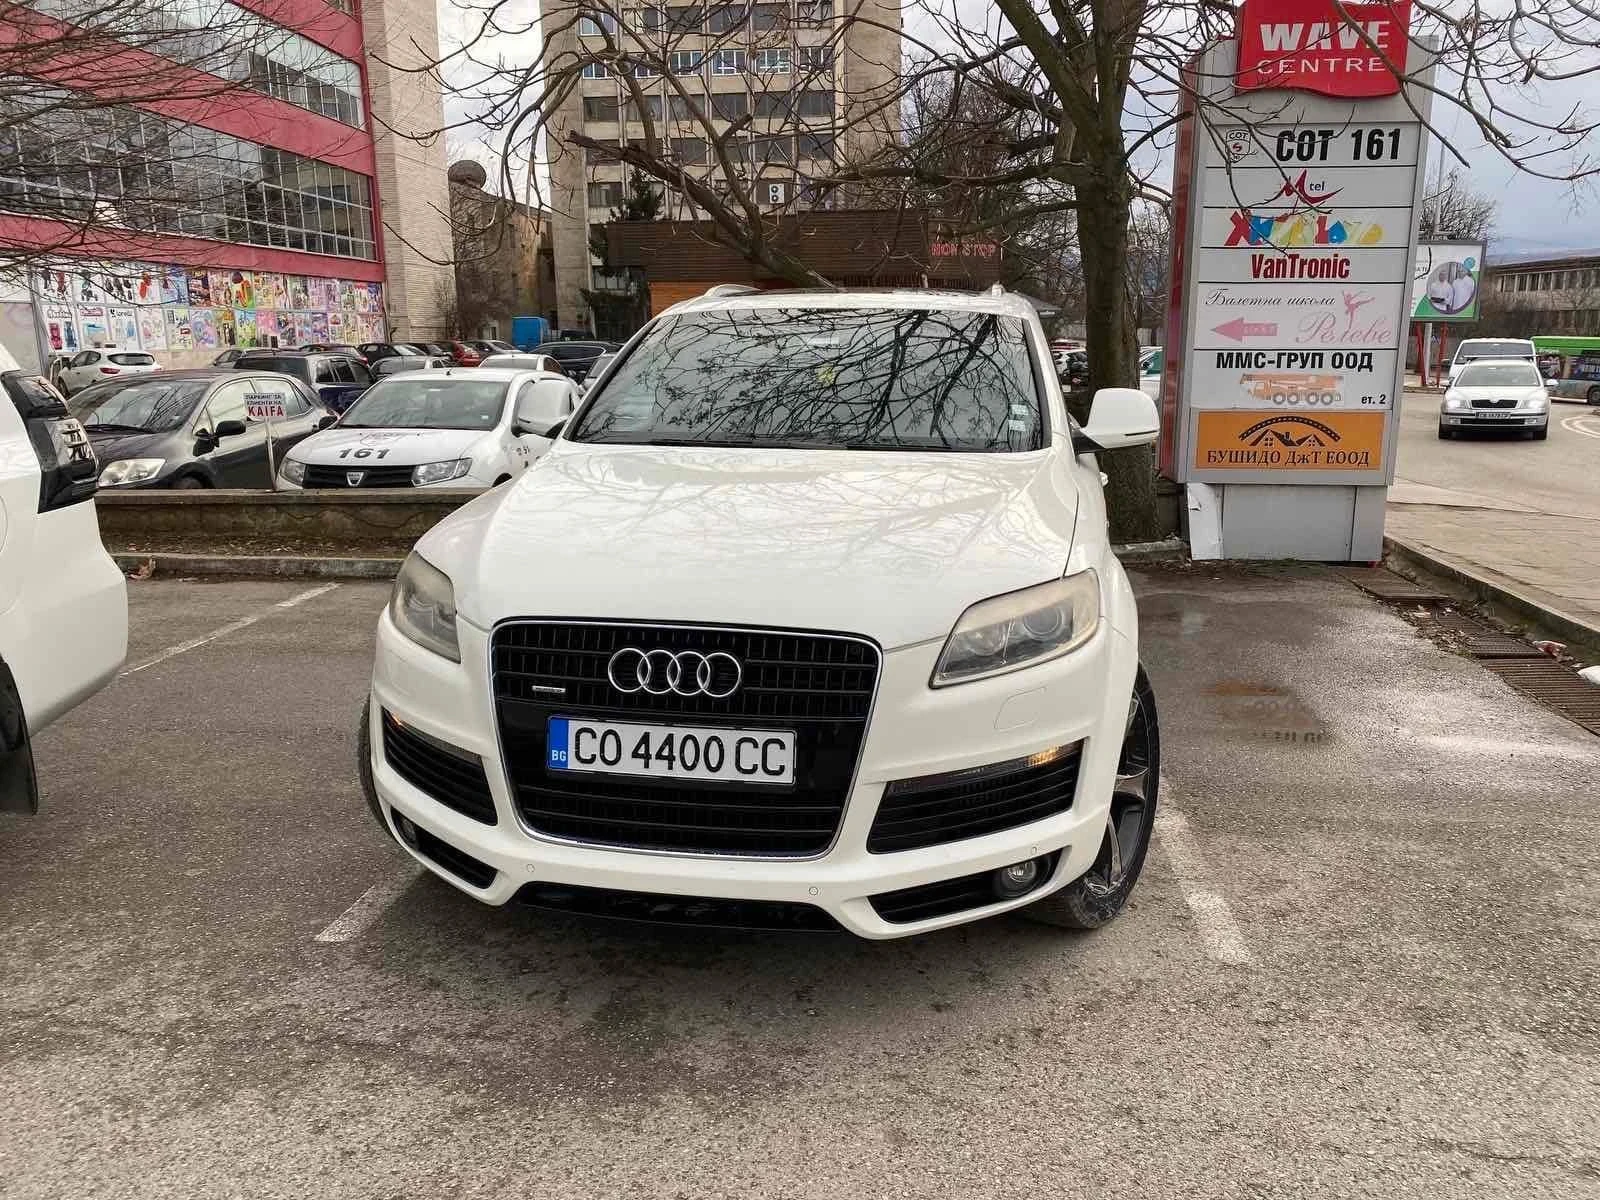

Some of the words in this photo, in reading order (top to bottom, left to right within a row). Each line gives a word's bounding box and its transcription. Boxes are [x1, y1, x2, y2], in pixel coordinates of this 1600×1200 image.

[1260, 20, 1390, 51] WAVE
[1257, 57, 1386, 75] CENTRE
[1276, 128, 1334, 162] СОТ
[1351, 127, 1401, 161] 161
[1250, 253, 1350, 279] VanTronic
[1216, 351, 1323, 369] ММС-ГРУП
[1331, 352, 1374, 373] ООД
[1361, 395, 1376, 405] ет.
[1379, 394, 1387, 405] 2
[248, 405, 284, 417] KAIFA
[339, 448, 390, 459] 161
[1207, 450, 1281, 467] БУШИДО
[1326, 451, 1370, 467] ЕООД
[551, 750, 567, 762] BG
[574, 726, 622, 767] CO
[631, 731, 725, 773] 4400
[734, 736, 786, 776] CC
